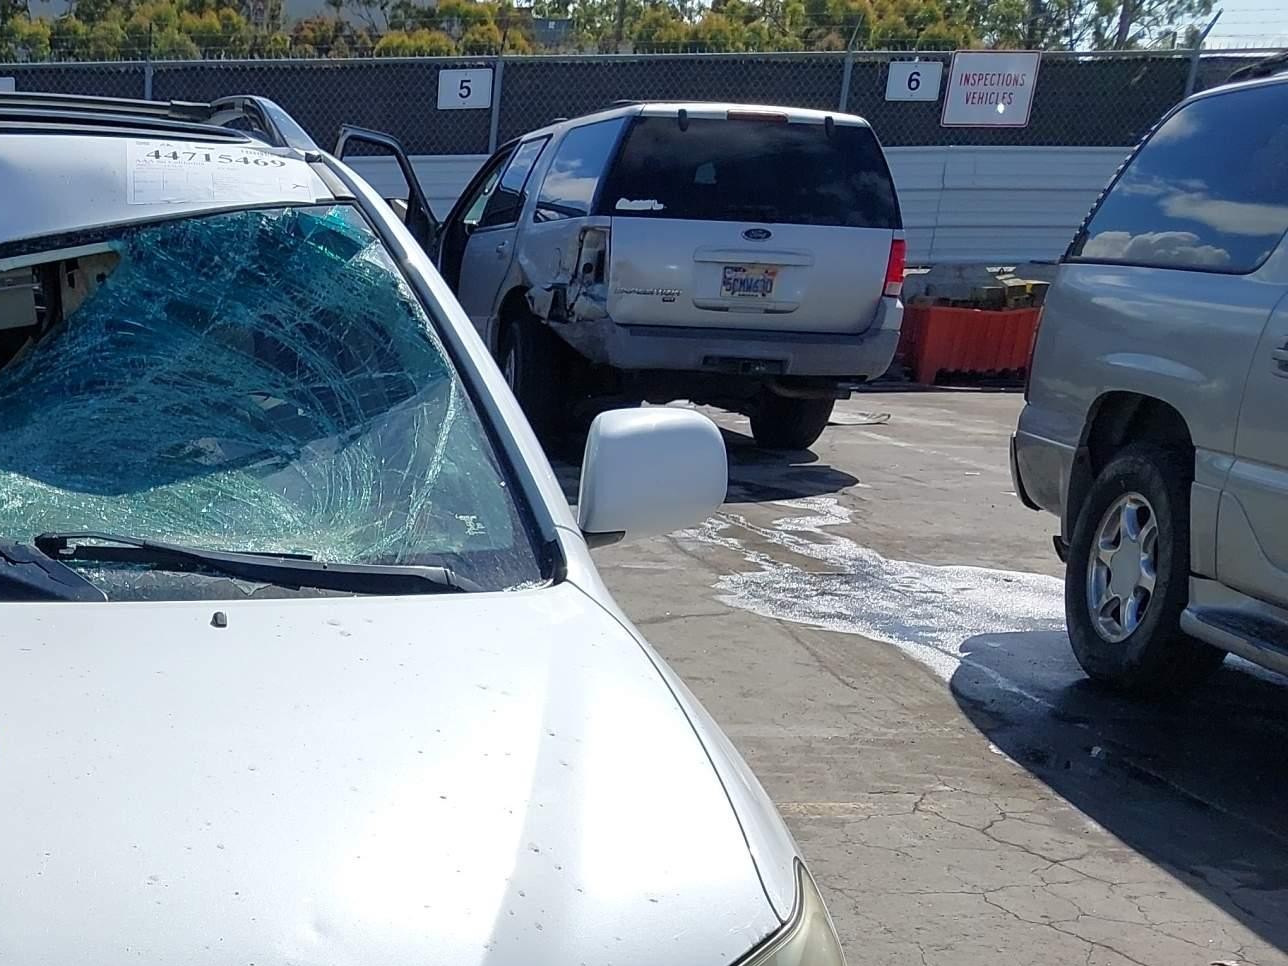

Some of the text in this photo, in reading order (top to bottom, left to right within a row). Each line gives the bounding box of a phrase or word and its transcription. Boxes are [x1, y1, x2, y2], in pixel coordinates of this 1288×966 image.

[458, 79, 472, 99] 5
[907, 71, 921, 91] 6
[959, 73, 1027, 87] INSPECTIONS
[965, 91, 1014, 105] VEHICLES
[145, 149, 286, 168] 44715469
